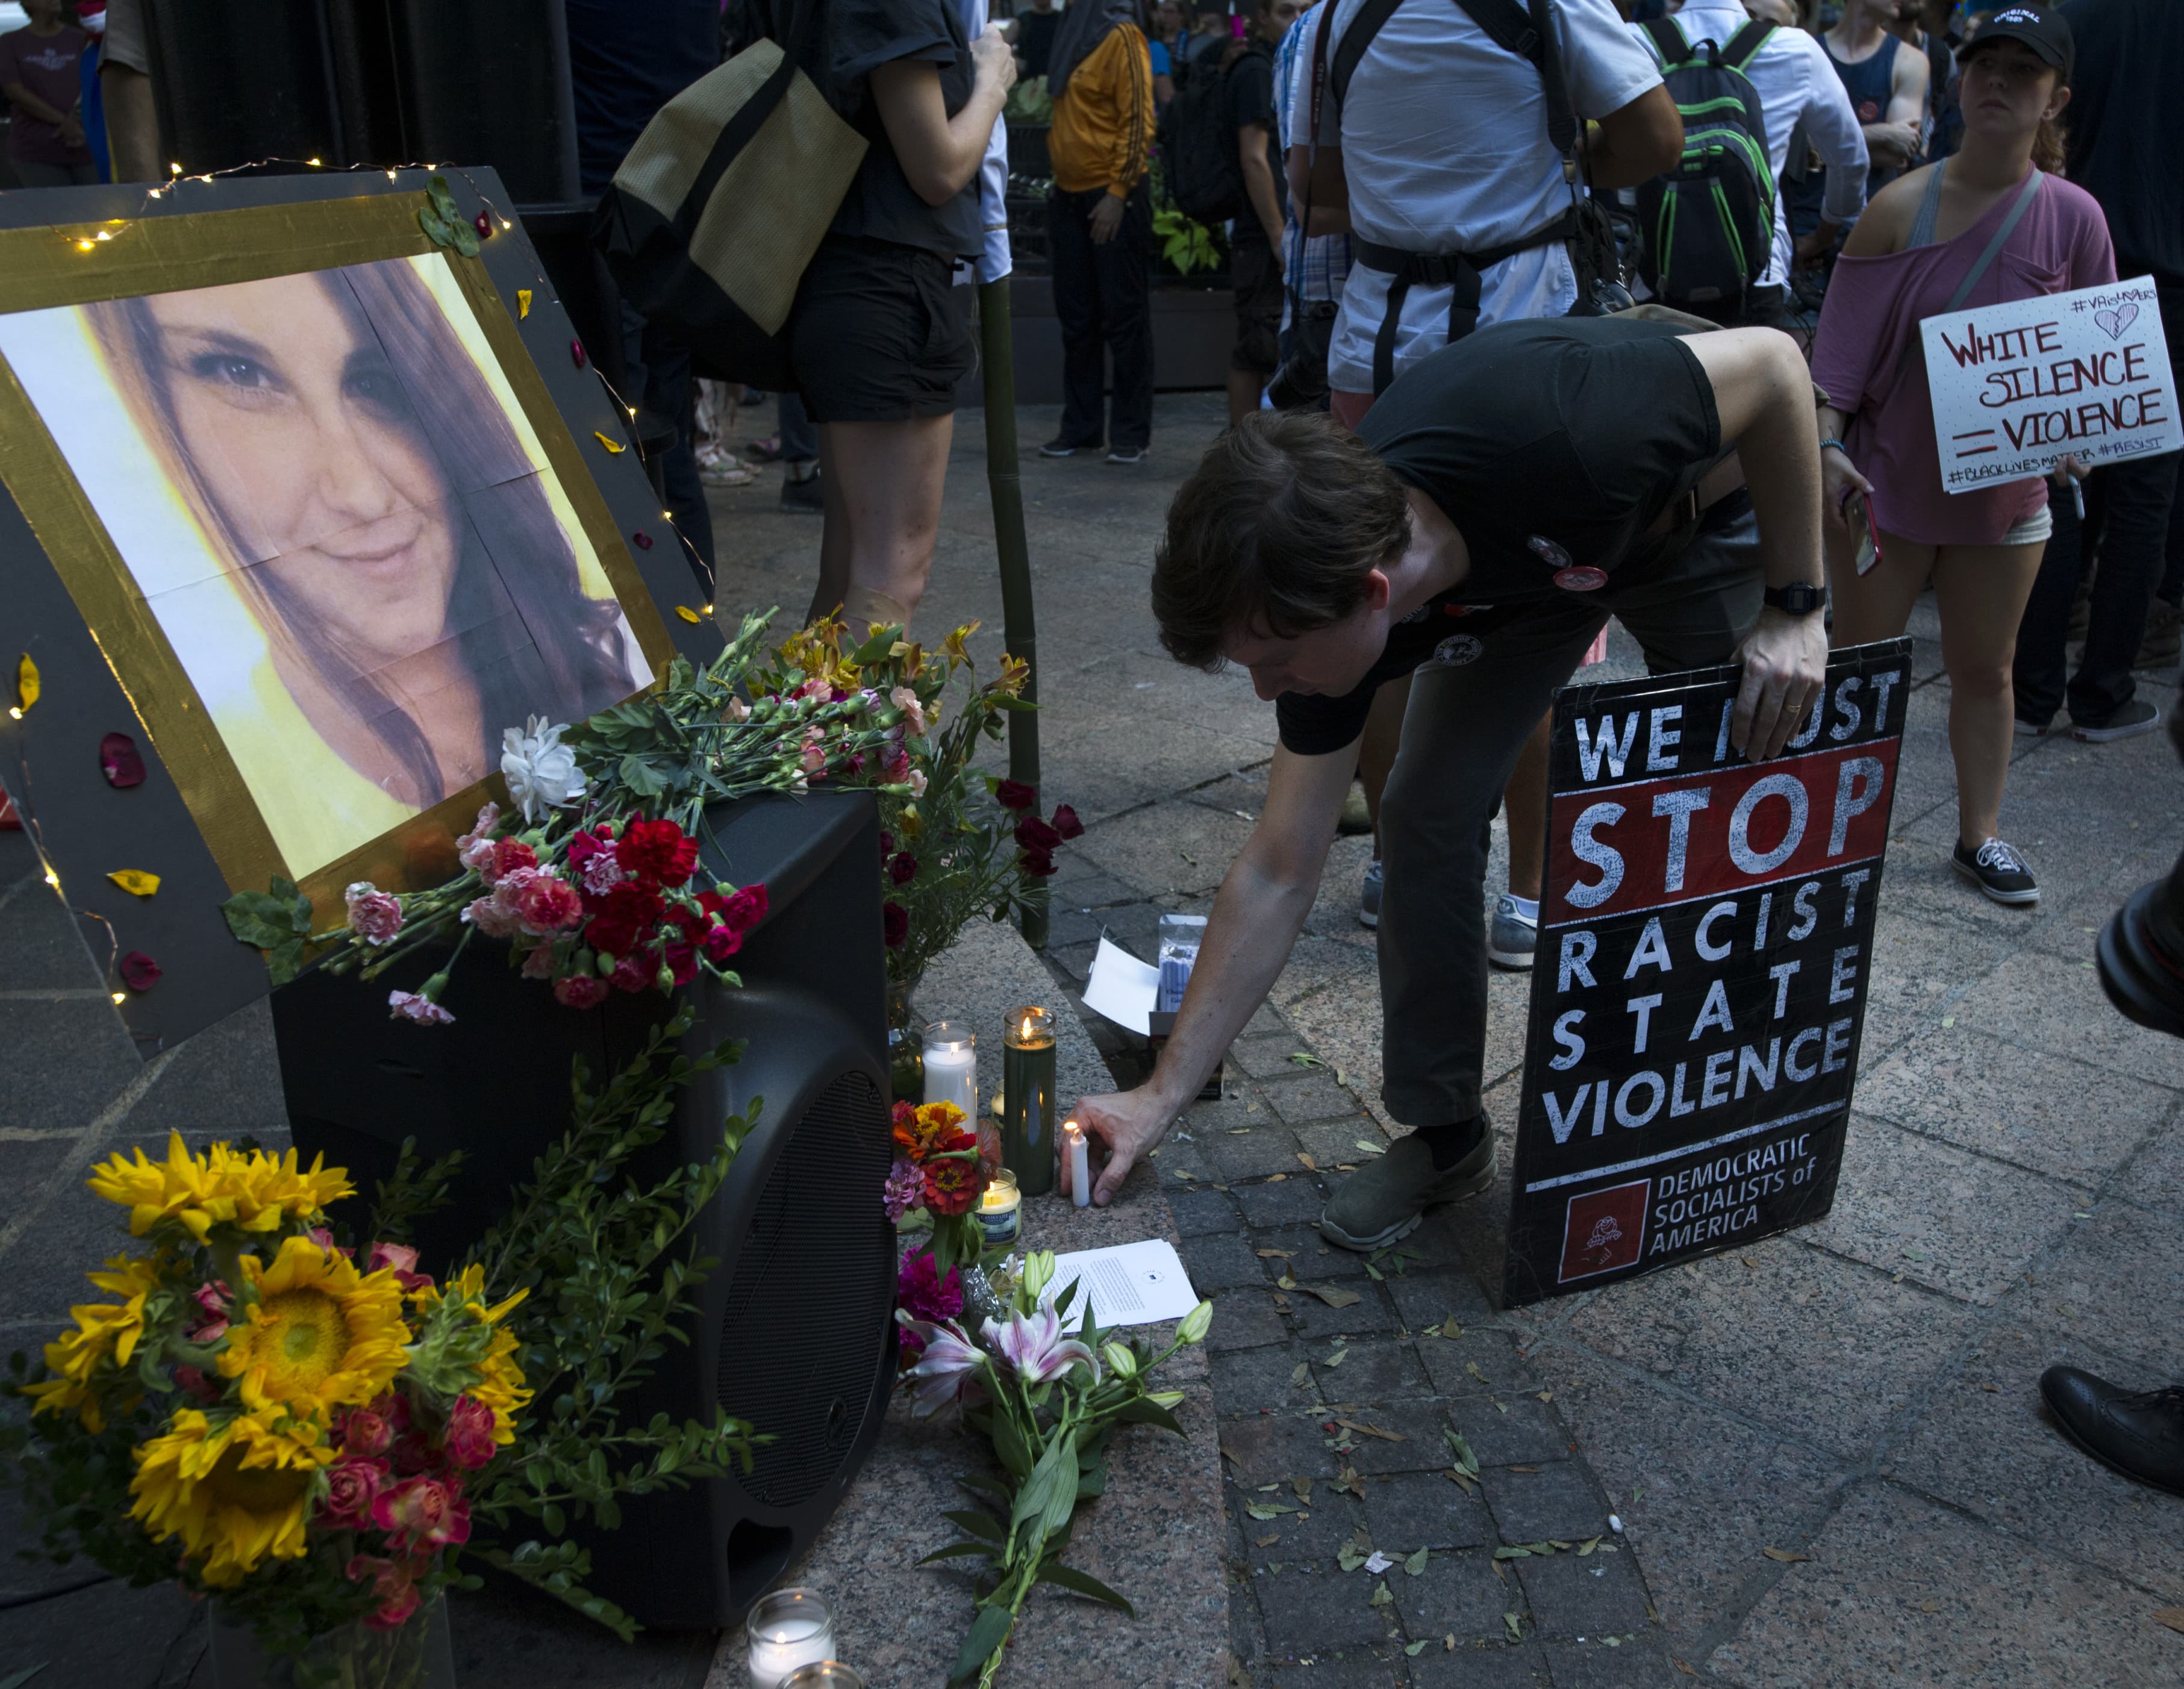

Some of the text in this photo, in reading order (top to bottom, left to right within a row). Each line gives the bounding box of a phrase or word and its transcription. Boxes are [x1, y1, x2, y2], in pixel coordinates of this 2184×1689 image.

[1941, 322, 2062, 369] WHITE
[1979, 343, 2150, 408] SILENCE
[2002, 388, 2168, 451] VIOLENCE
[1574, 705, 1683, 781] WE
[1564, 756, 1885, 908] STOP
[1557, 869, 1870, 993] RACIST
[1548, 946, 1858, 1070] STATE
[1542, 1017, 1852, 1144] VIOLENCE
[1654, 1157, 1817, 1229] SOCIALISTS of
[1658, 1133, 1810, 1199] DEMOCRATIC
[1649, 1204, 1758, 1256] AMERICA
